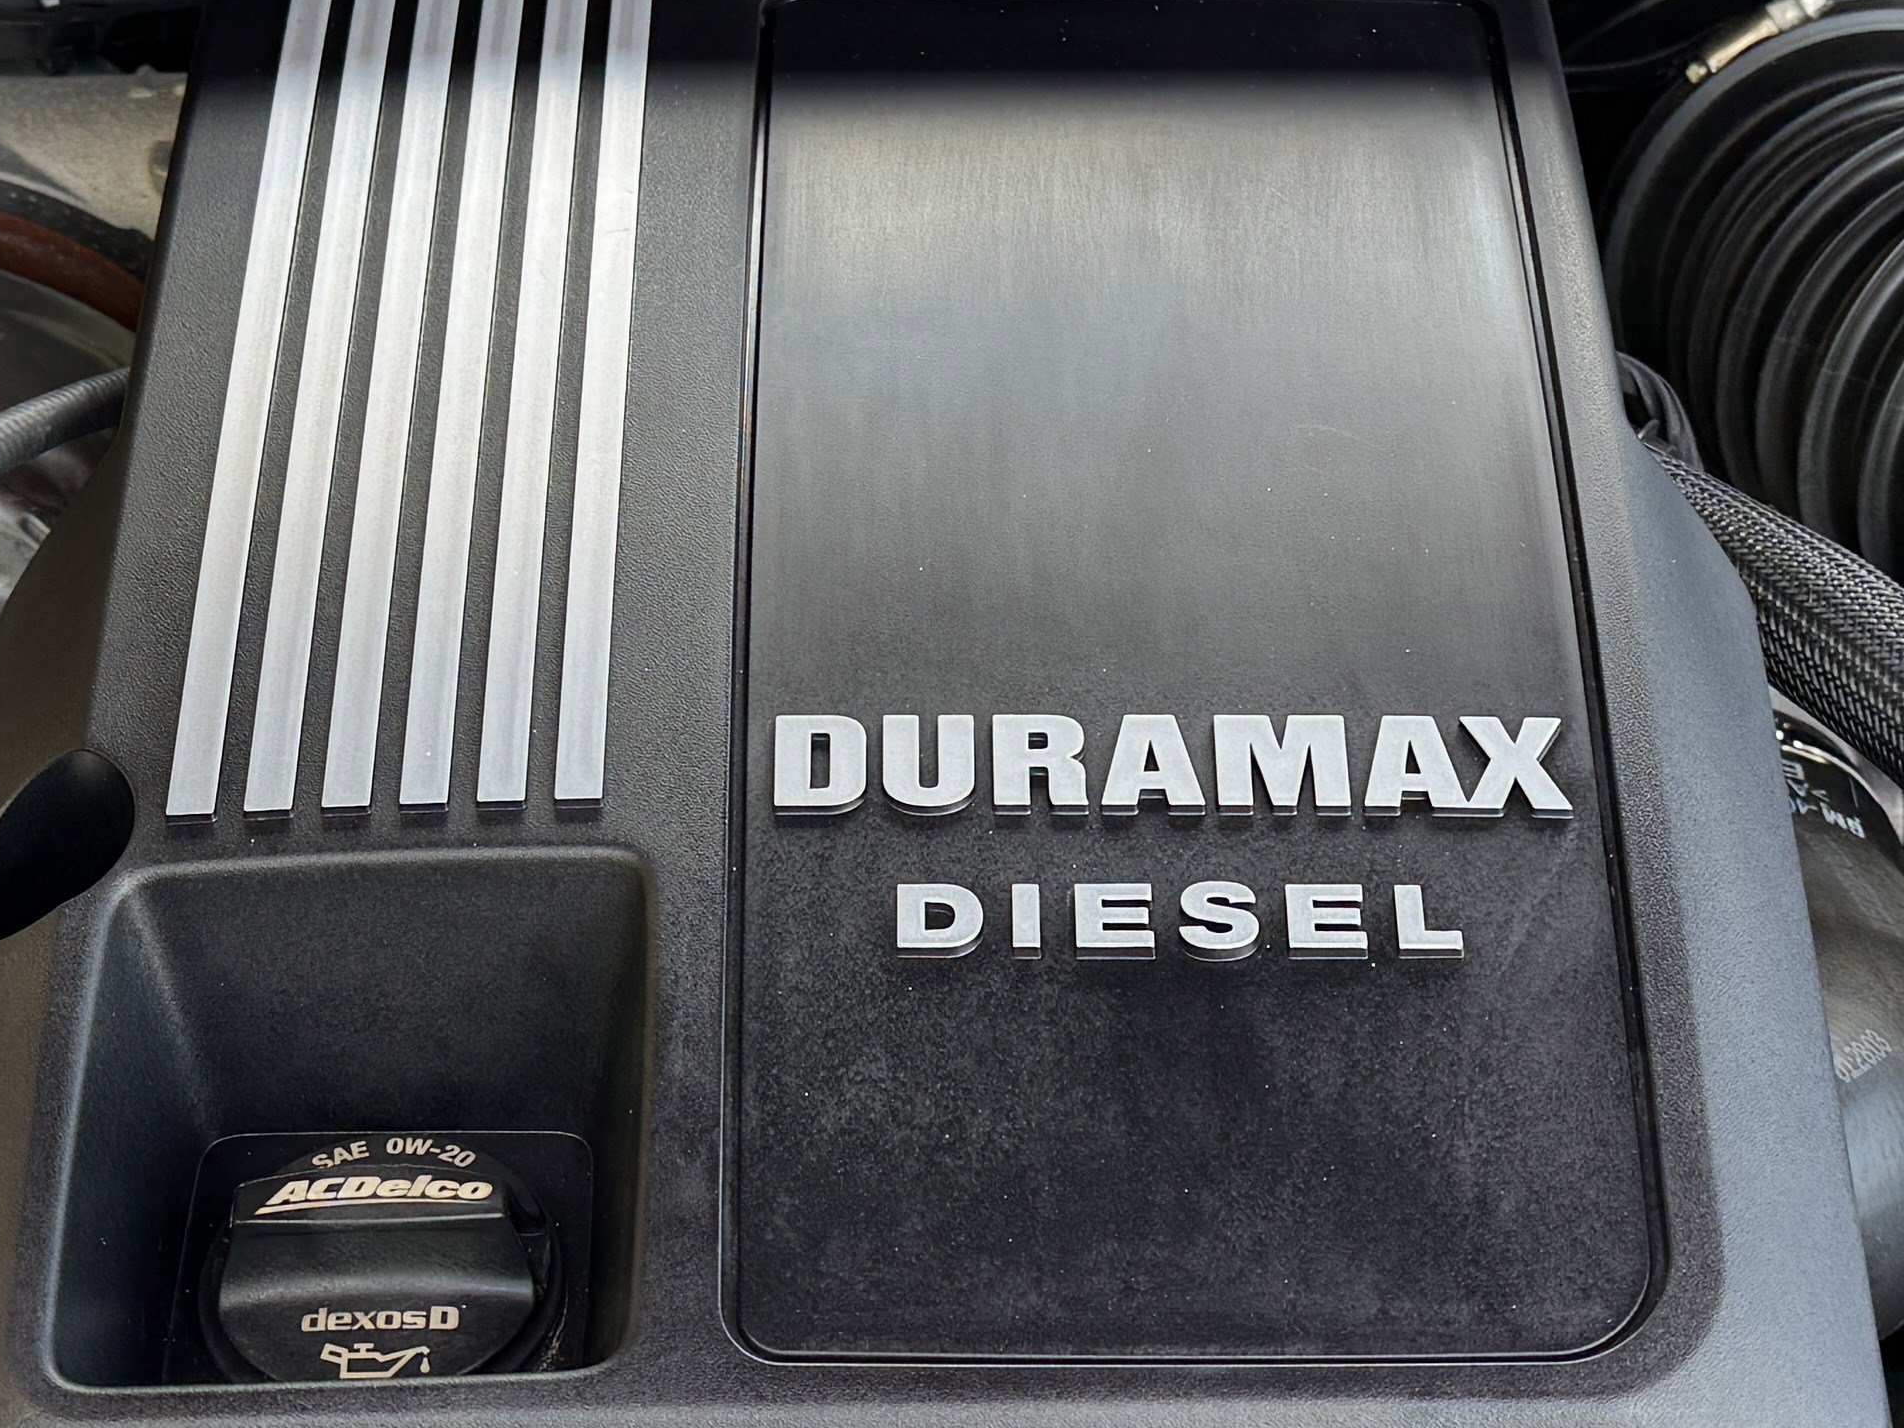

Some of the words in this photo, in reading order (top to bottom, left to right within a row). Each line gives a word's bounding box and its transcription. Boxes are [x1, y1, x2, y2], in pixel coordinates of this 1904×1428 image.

[773, 713, 1574, 820] DURAMAX
[896, 880, 1465, 962] DIESEL
[312, 1140, 370, 1170] SAE
[386, 1136, 477, 1169] 0W-20
[262, 1174, 494, 1208] ACDelco
